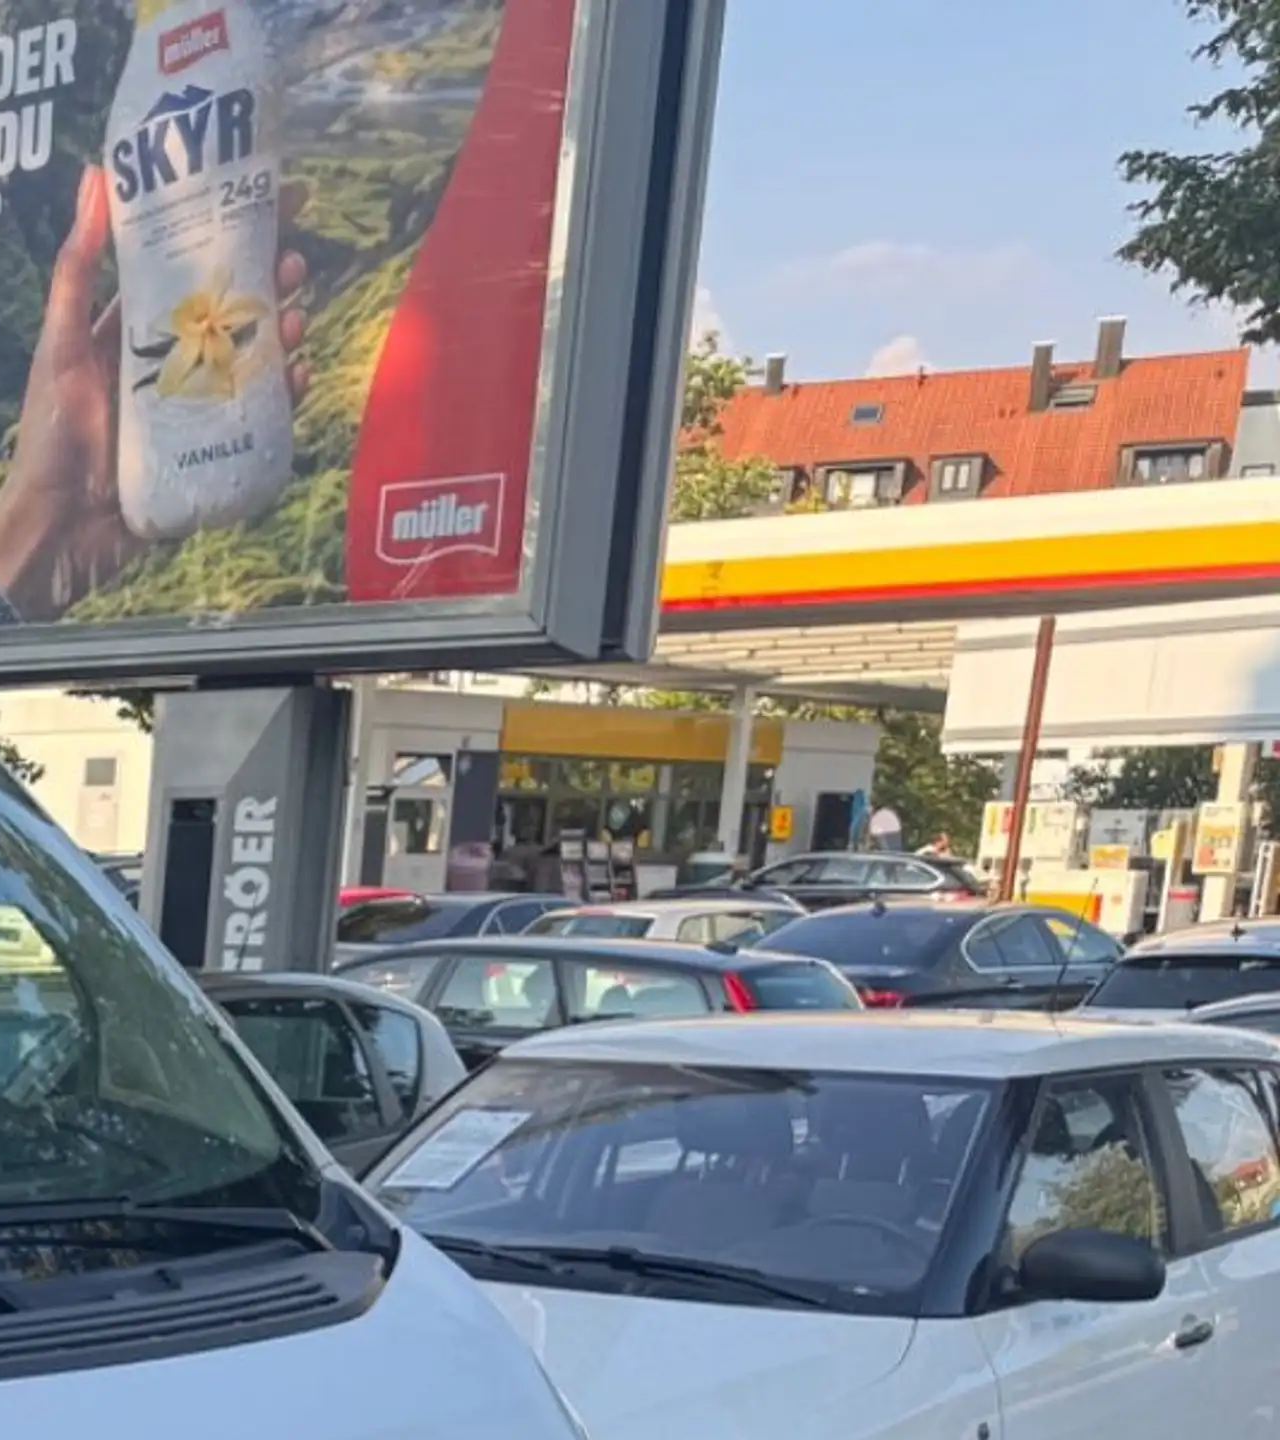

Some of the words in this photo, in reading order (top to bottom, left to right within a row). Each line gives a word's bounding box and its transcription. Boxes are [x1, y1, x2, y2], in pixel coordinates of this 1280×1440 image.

[112, 87, 255, 203] SKYR
[175, 432, 255, 469] VANILLE
[391, 493, 487, 541] müller
